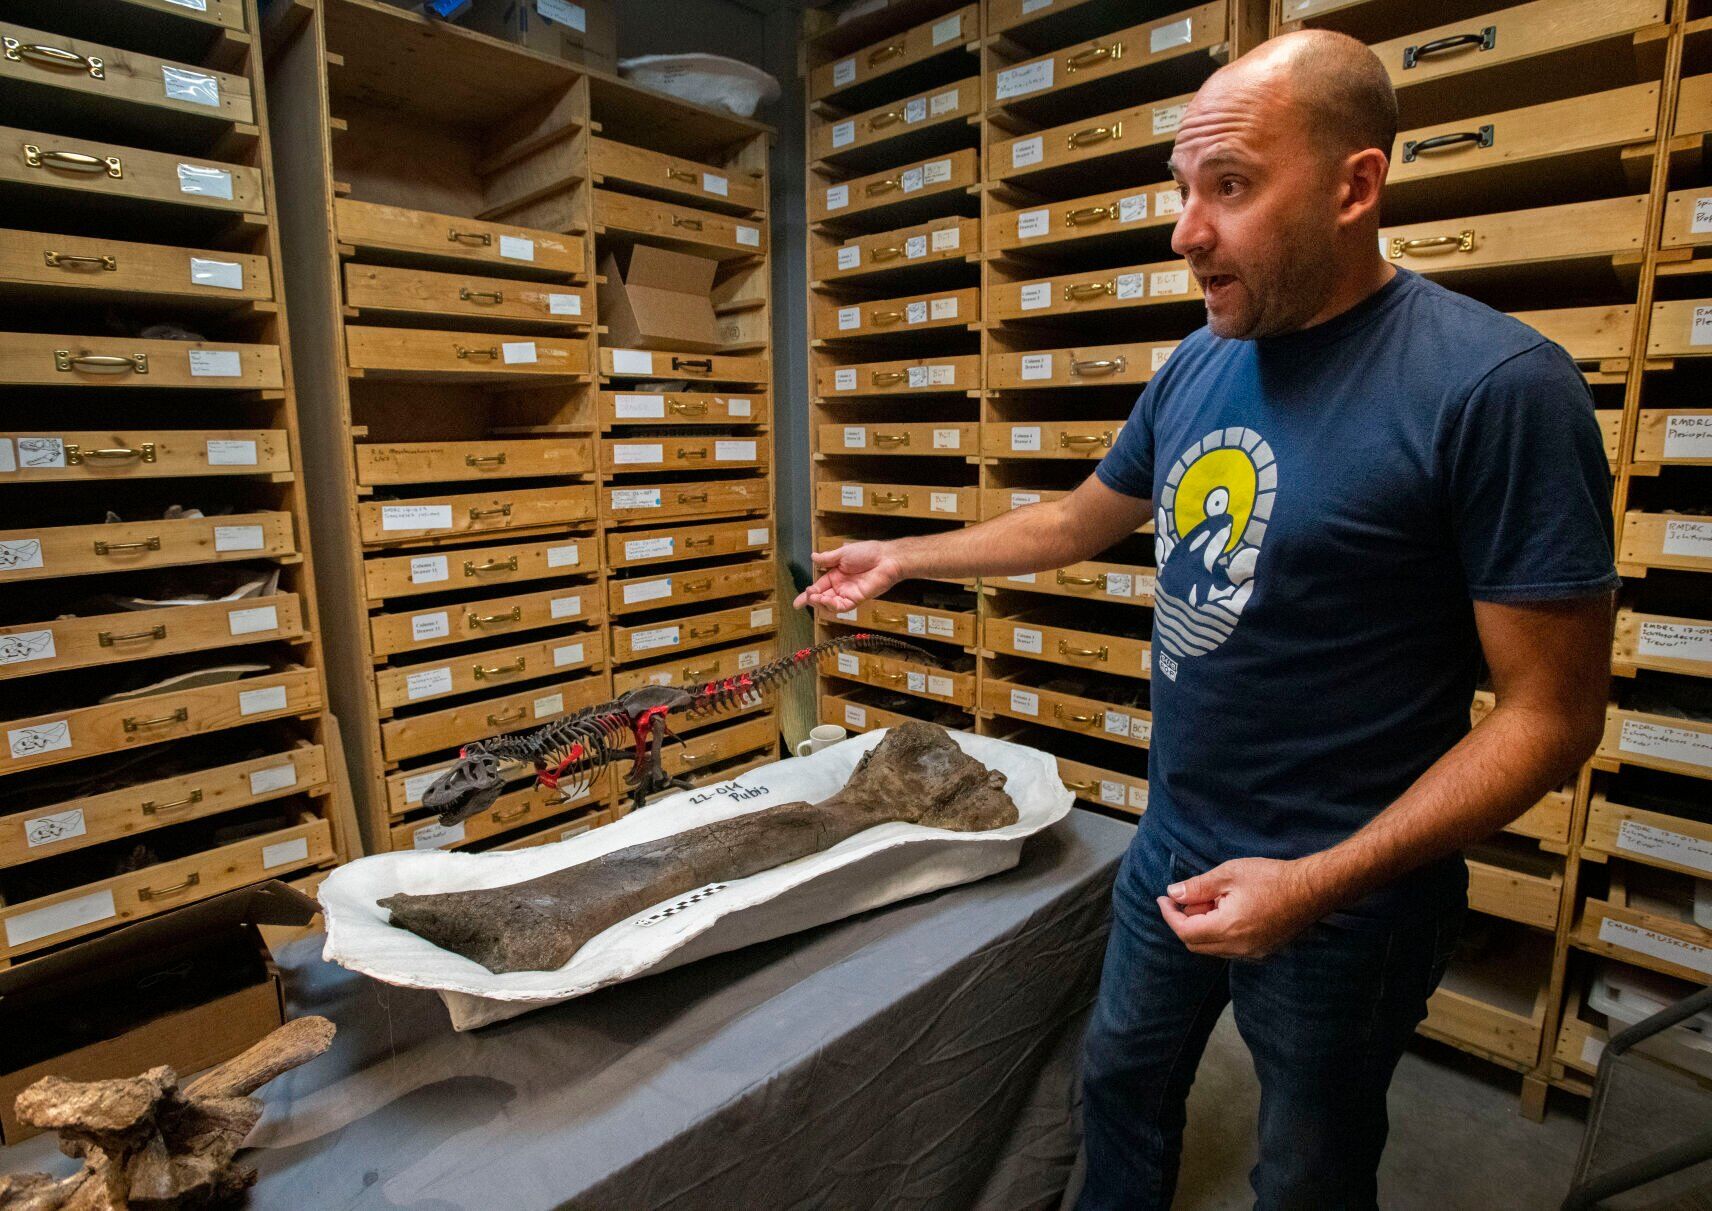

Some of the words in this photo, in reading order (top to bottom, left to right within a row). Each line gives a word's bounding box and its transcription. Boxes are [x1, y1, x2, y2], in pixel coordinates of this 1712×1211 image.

[1156, 273, 1179, 285] BCT
[934, 301, 949, 311] BCT
[932, 368, 947, 378] BCT
[1670, 418, 1712, 427] RMDRC
[1668, 522, 1704, 533] RMDRC
[1643, 623, 1675, 632] RMDRC
[1132, 723, 1149, 734] BCT
[1624, 721, 1657, 732] RMDRC
[728, 785, 769, 802] Pubis
[1645, 931, 1704, 953] MUSKRAT
